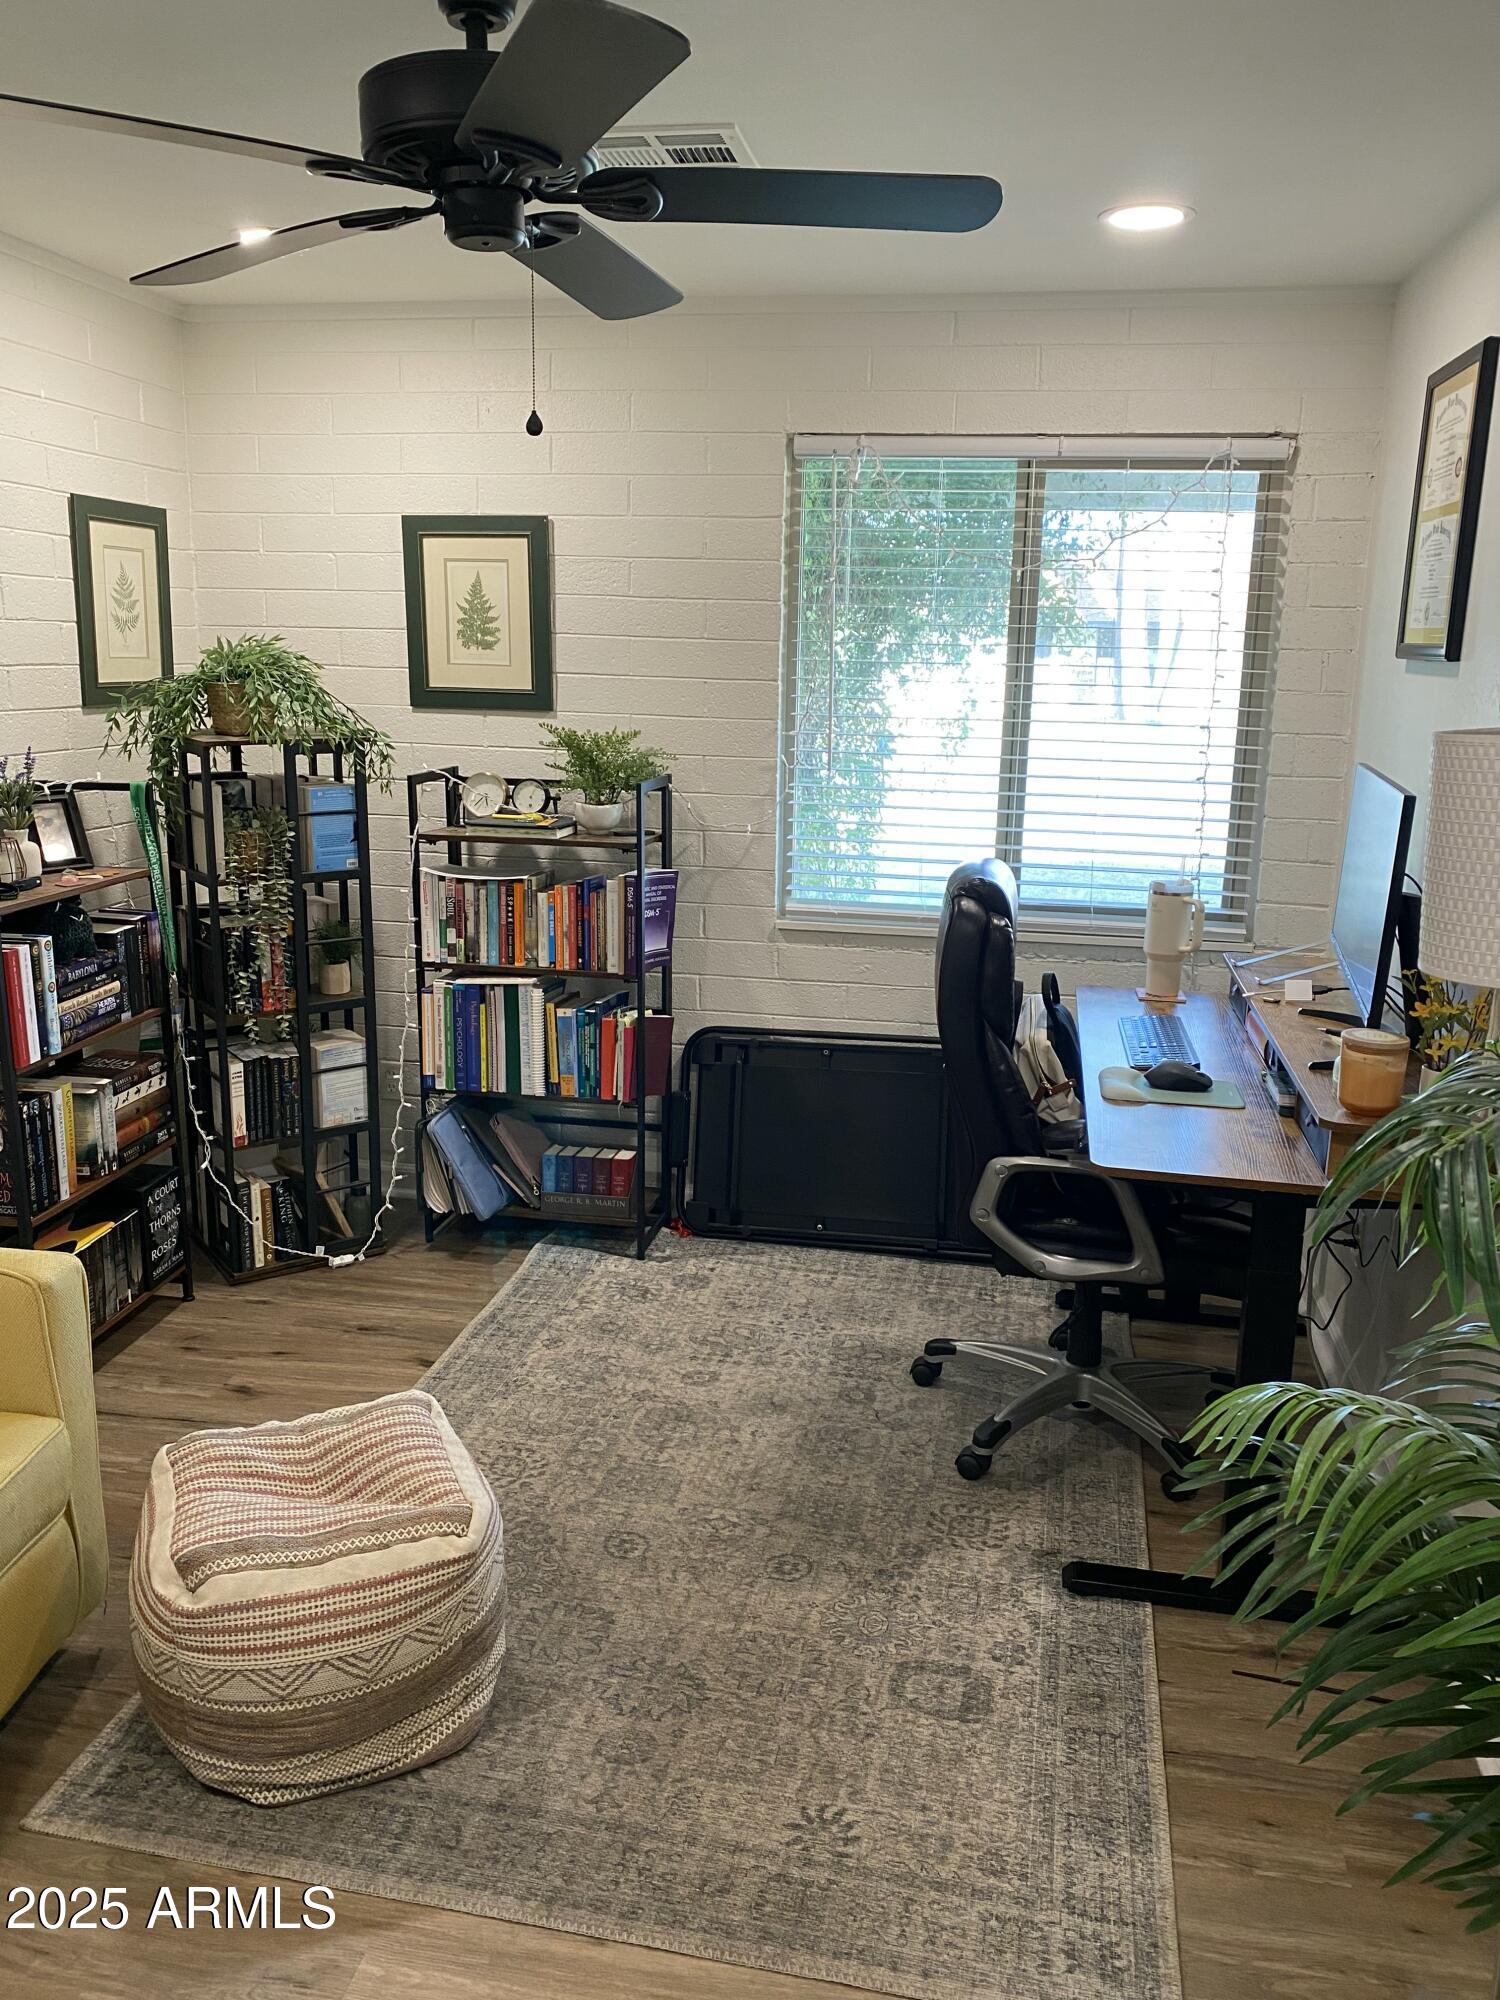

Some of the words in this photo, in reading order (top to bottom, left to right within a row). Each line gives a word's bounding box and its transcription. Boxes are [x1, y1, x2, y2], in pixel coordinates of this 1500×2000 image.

[446, 898, 455, 916] SOUL
[644, 908, 661, 918] DSM-5
[68, 964, 98, 982] BABYLONIA
[148, 1196, 154, 1206] A
[154, 1176, 178, 1200] COURT
[155, 1202, 163, 1214] OF
[278, 1197, 288, 1222] KING
[284, 1192, 294, 1224] STEPHEN
[544, 1196, 575, 1204] GEORGE
[595, 1199, 626, 1208] MARTIN
[149, 1204, 181, 1233] THORNS
[168, 1220, 178, 1233] AND
[151, 1235, 177, 1261] ROSES
